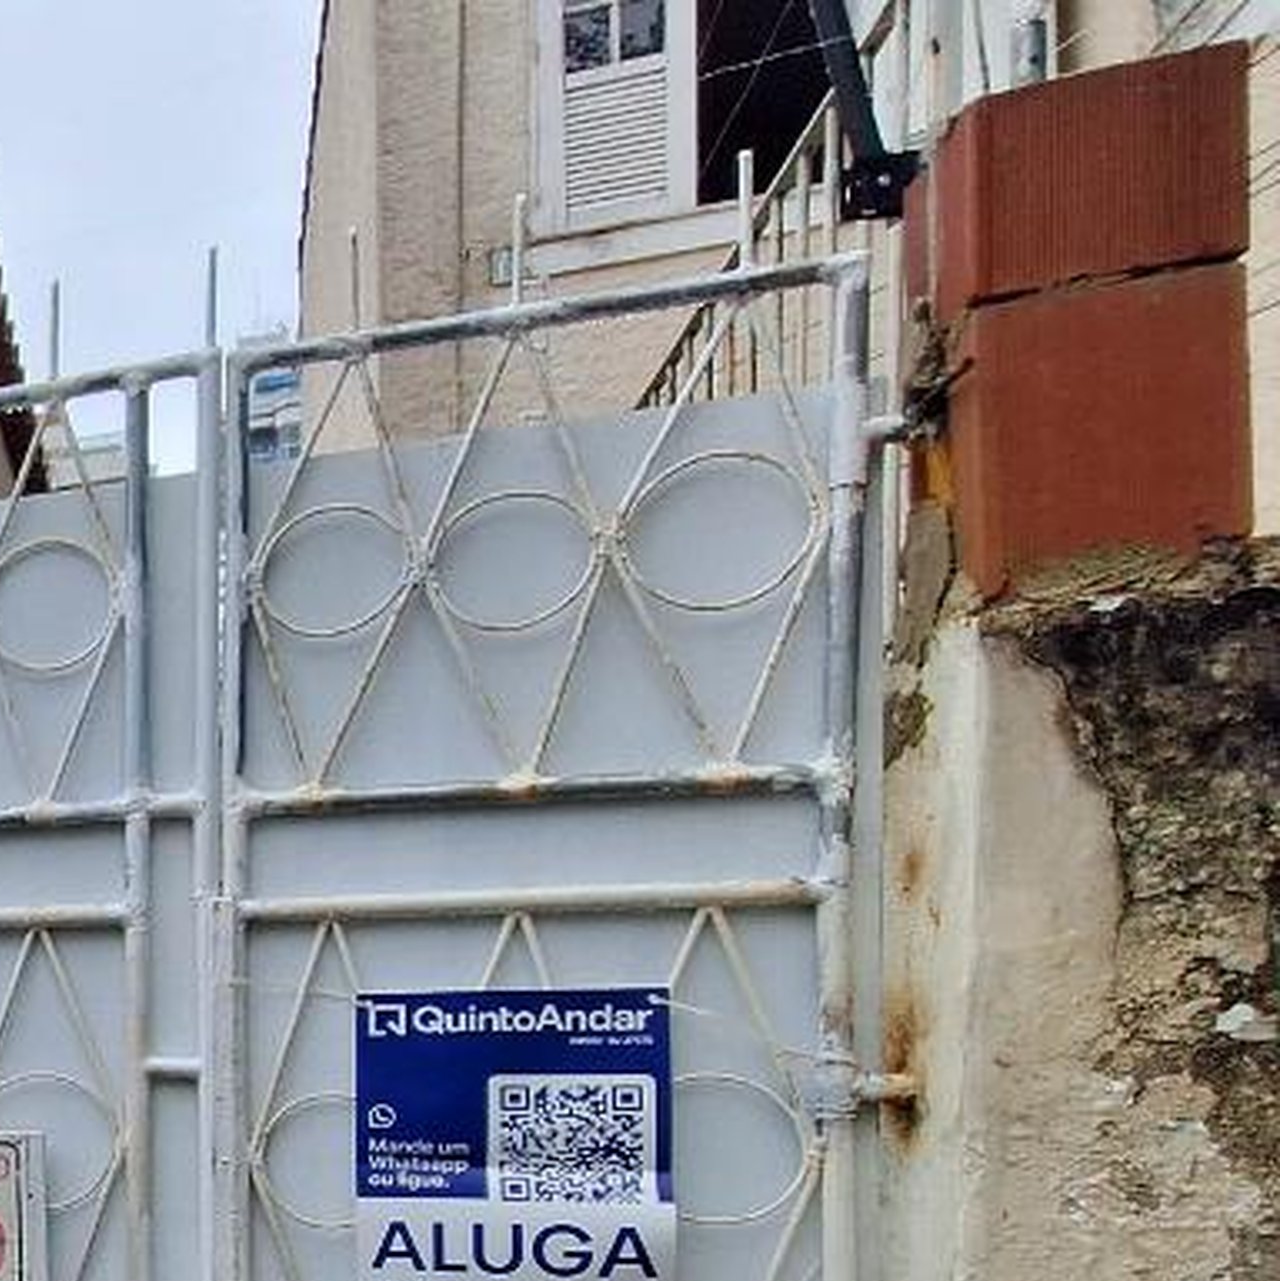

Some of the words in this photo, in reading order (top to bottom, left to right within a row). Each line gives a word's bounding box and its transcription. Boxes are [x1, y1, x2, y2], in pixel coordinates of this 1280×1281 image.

[413, 1003, 653, 1035] QuintoAndar
[438, 1143, 470, 1155] um
[369, 1174, 393, 1186] ou
[372, 1221, 658, 1278] ALUGA
